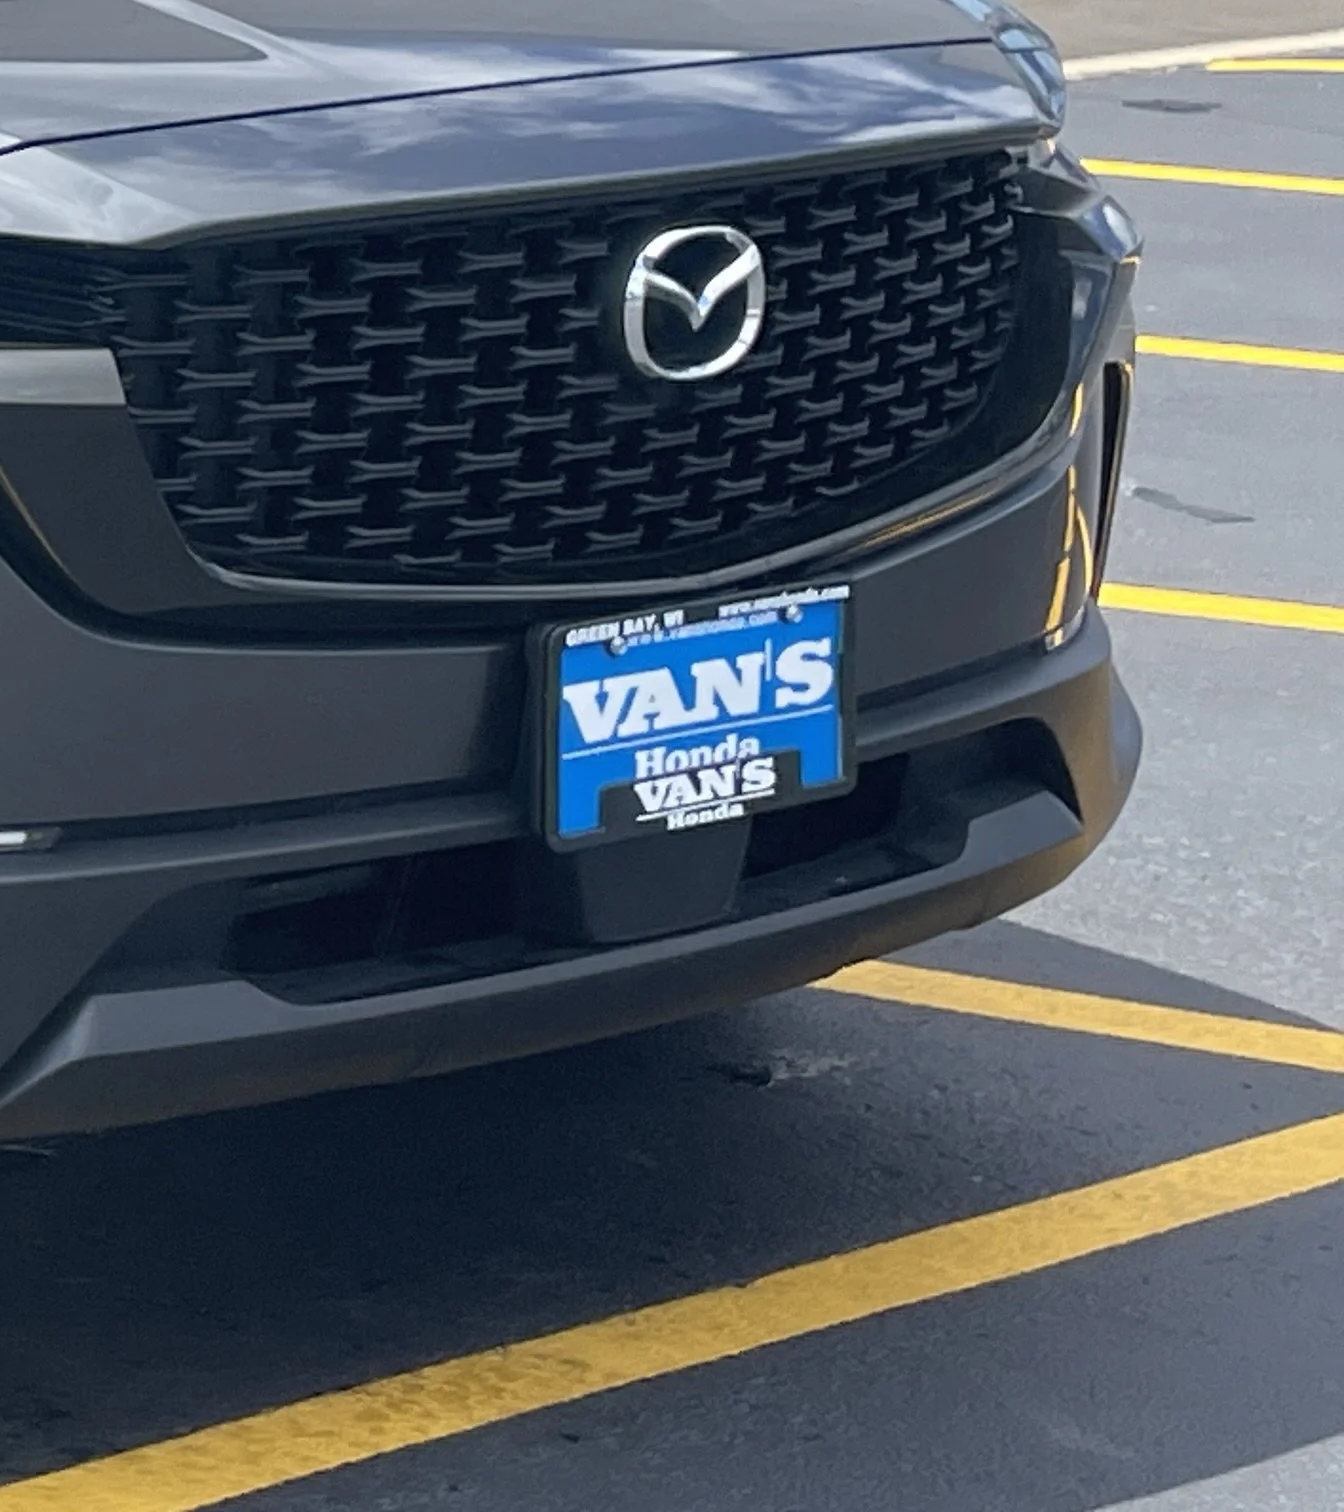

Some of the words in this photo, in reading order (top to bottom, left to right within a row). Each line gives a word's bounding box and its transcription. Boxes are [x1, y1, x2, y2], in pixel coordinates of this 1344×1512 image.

[563, 637, 835, 744] VAN'S
[635, 733, 760, 779] Honda
[633, 756, 776, 813] VAN'S
[666, 801, 745, 831] Honda
